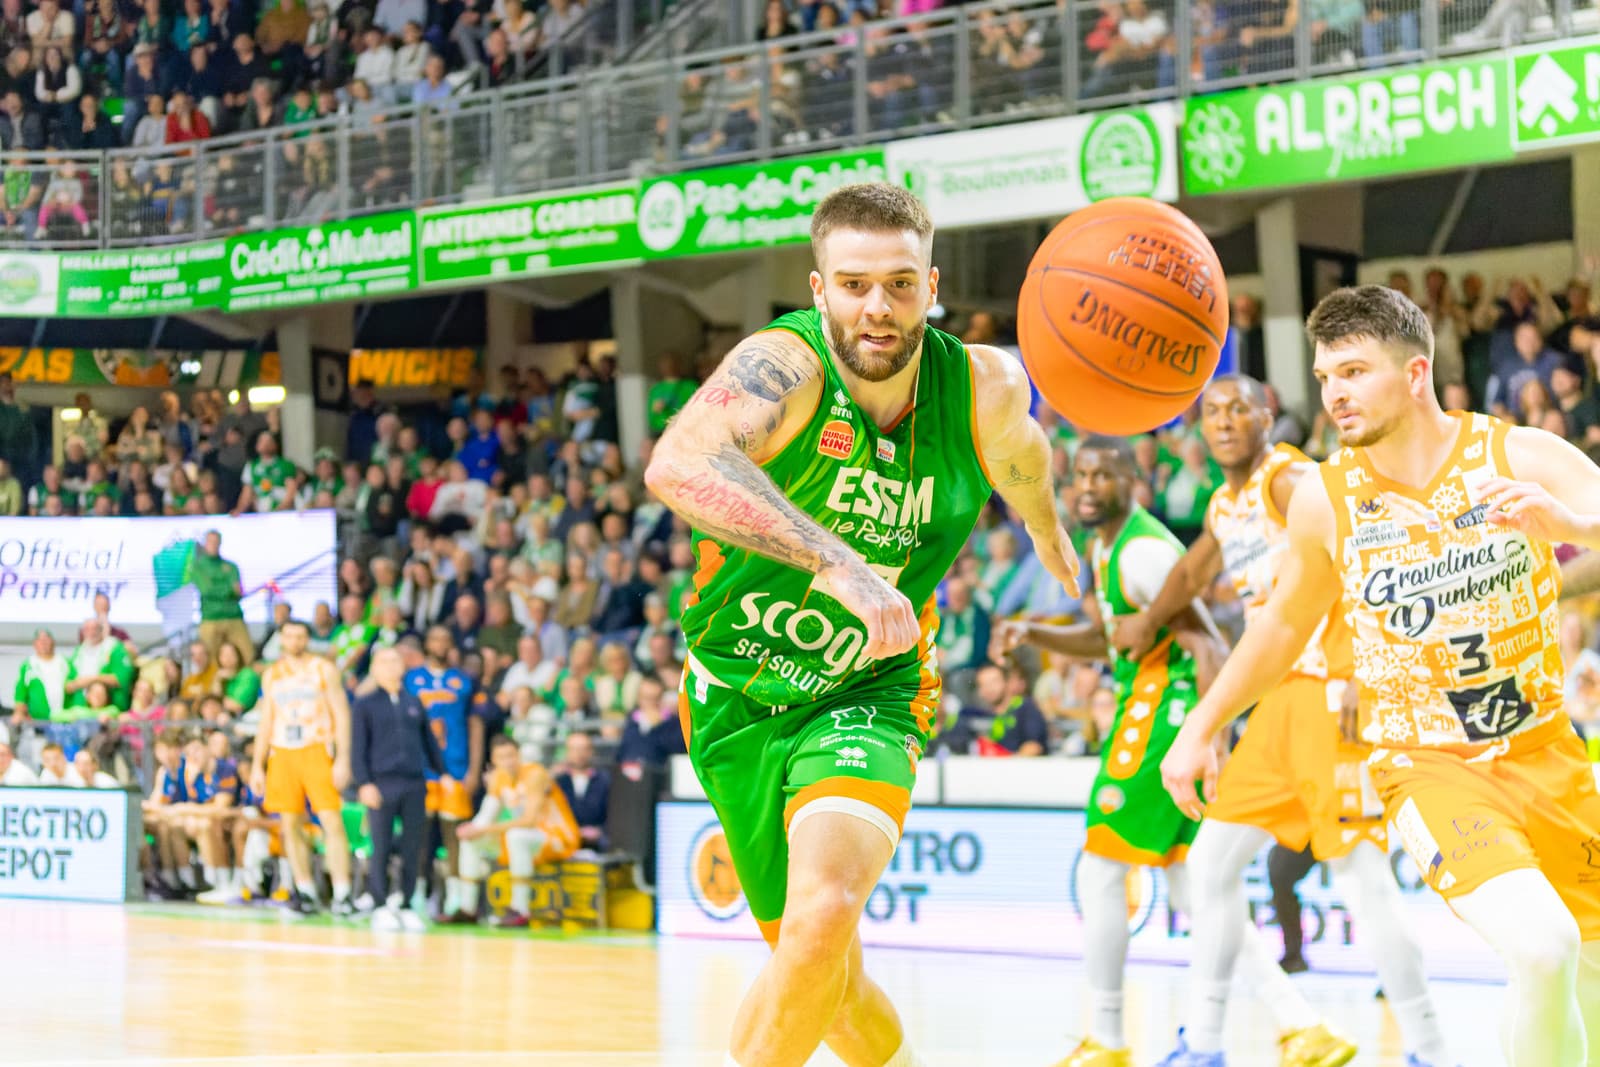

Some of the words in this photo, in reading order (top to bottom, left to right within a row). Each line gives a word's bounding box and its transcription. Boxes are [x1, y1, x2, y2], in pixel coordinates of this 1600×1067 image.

[1255, 65, 1496, 154] ALPRECH
[684, 159, 884, 218] Pas-de-Calais
[421, 206, 533, 249] ANTENNES
[536, 194, 636, 234] CORDIER
[231, 238, 301, 280] Crédit
[329, 221, 411, 266] Mutuel
[1071, 288, 1206, 376] SPALDING
[820, 437, 852, 453] KING
[825, 466, 935, 527] ESSM
[0, 538, 125, 569] Official
[1350, 528, 1408, 547] LEMPEREUR
[1369, 540, 1431, 567] INCENDIE
[0, 569, 128, 601] Partner
[1364, 544, 1496, 606] Gravelines
[1390, 555, 1531, 638] Dunkerque
[733, 637, 770, 664] SEA
[1449, 632, 1491, 677] 3
[1494, 628, 1541, 659] ORTICA
[835, 758, 867, 769] errea
[0, 806, 107, 841] ECTRO
